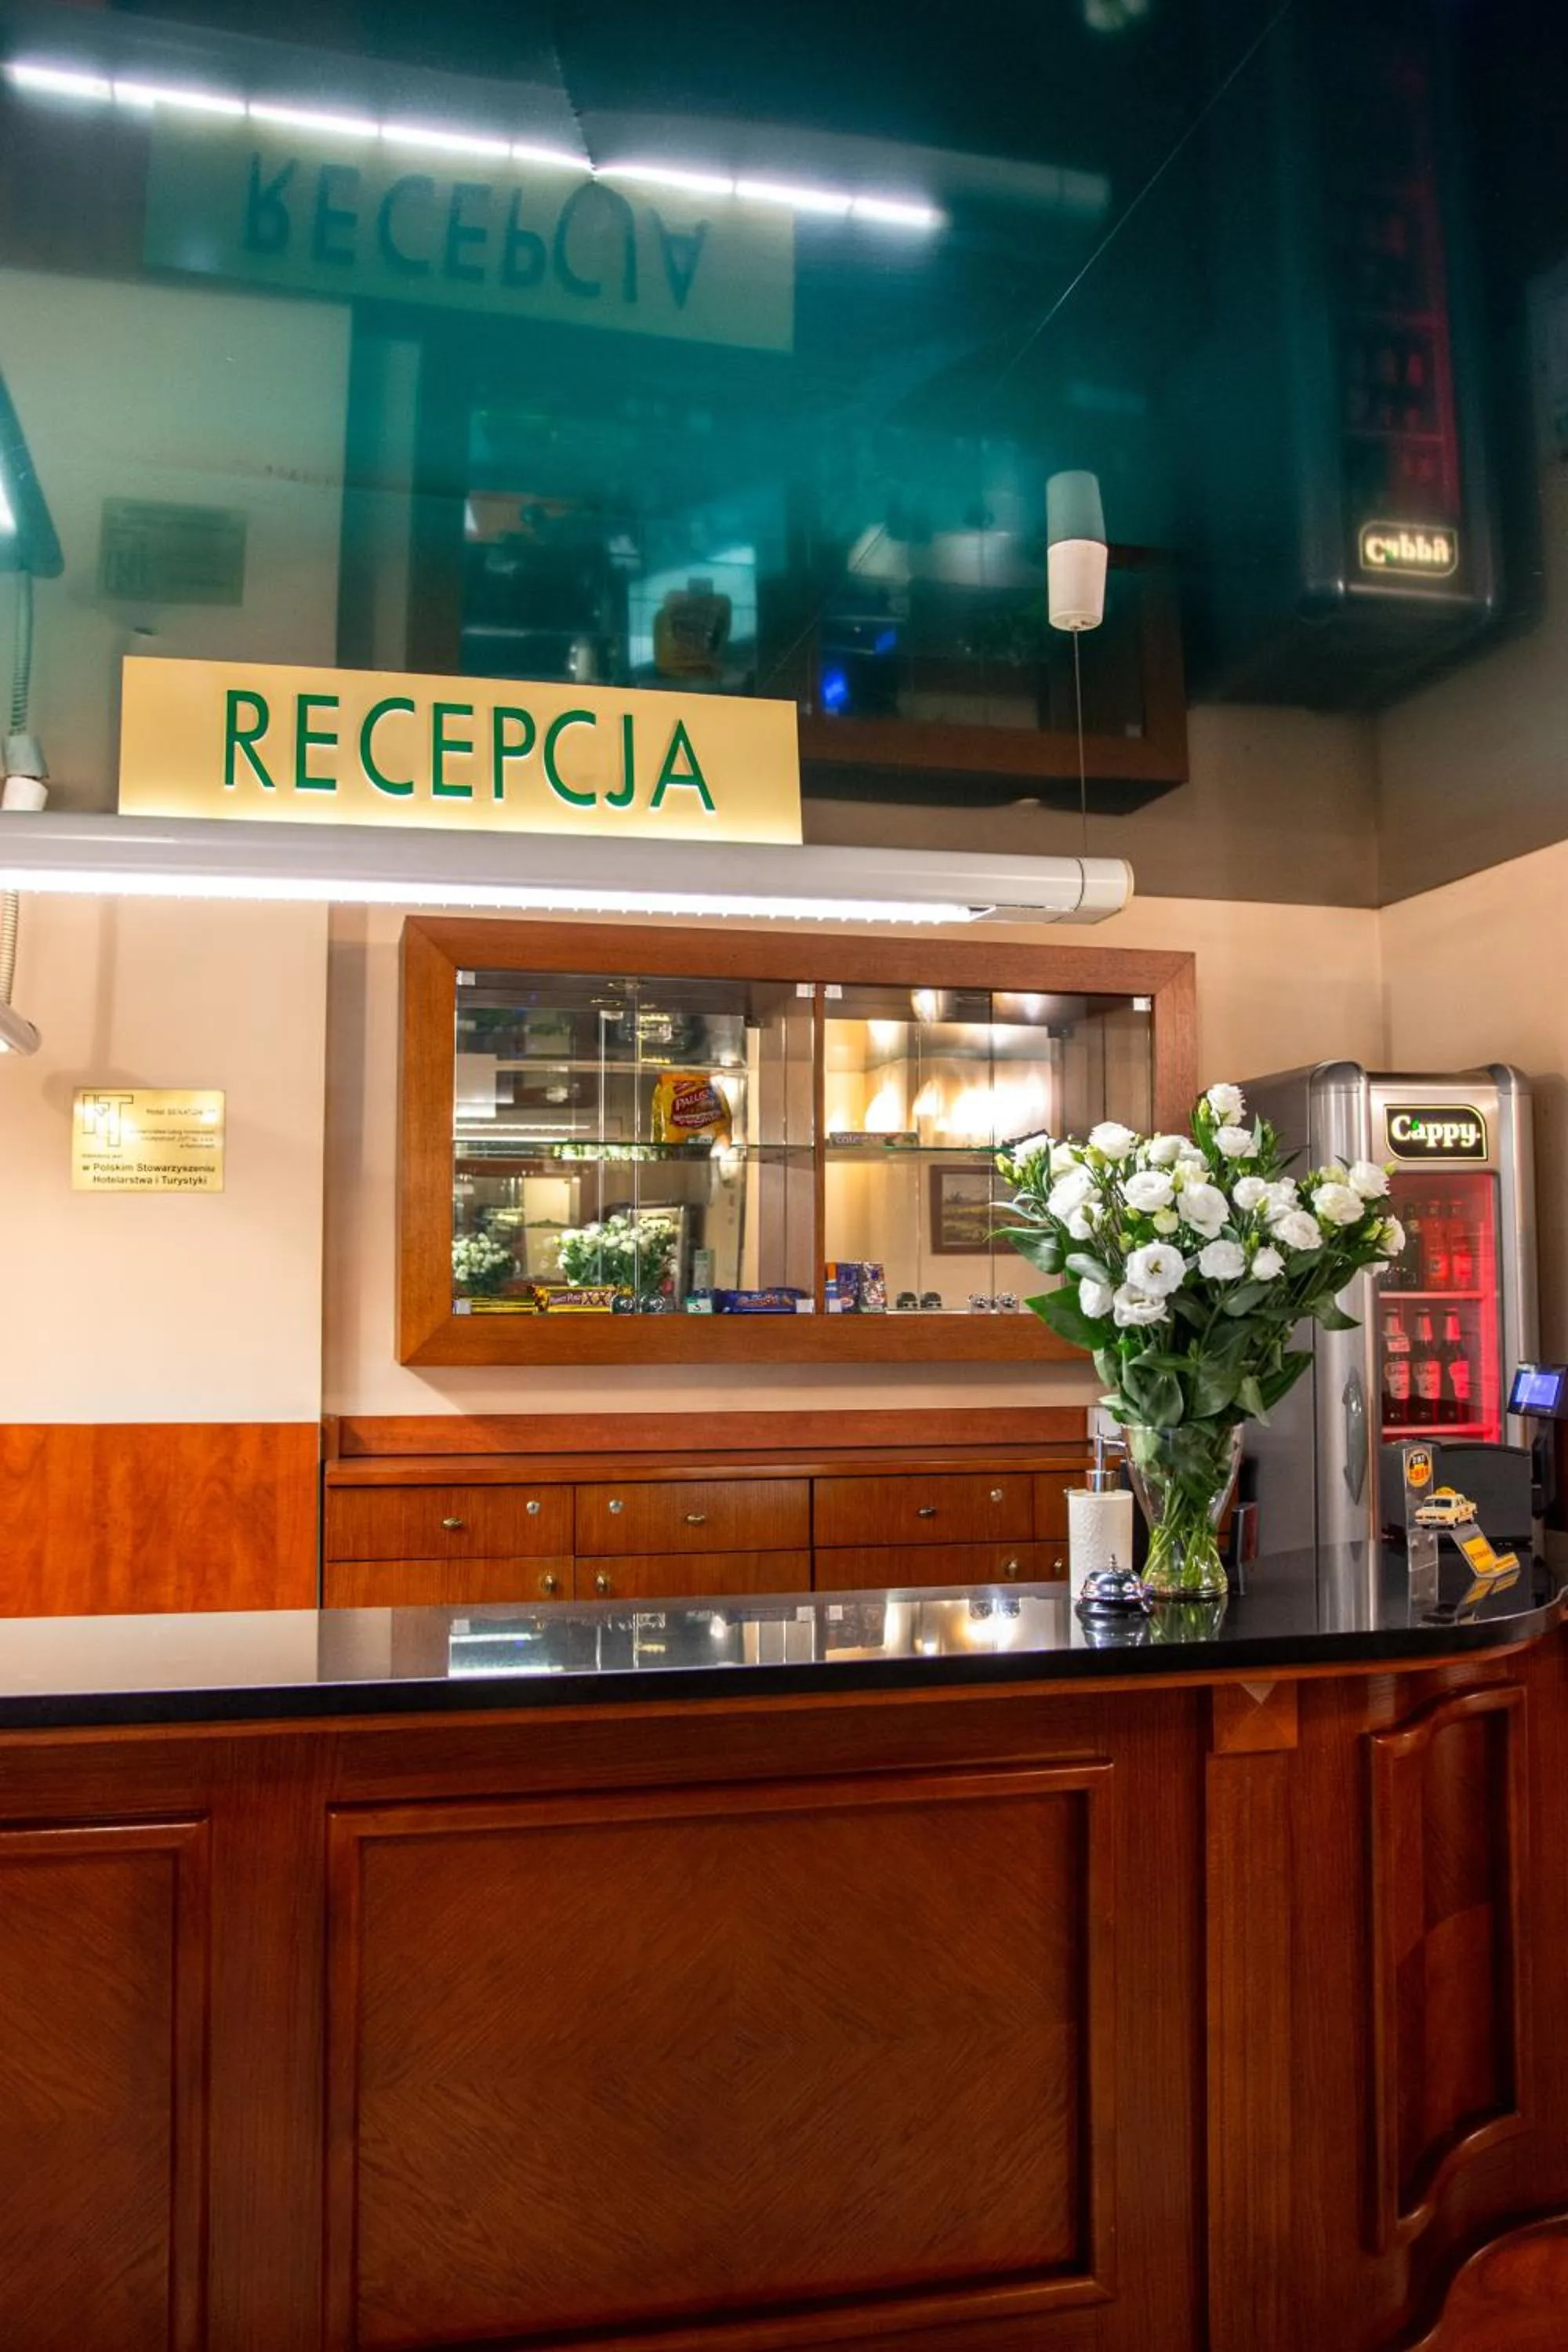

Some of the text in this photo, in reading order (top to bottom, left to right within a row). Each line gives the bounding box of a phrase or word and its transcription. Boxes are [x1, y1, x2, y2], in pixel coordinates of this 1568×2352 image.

[223, 688, 717, 813] RECEPCJA
[93, 1163, 134, 1172] Polskim
[137, 1163, 216, 1174] Stowarzyszeniu
[93, 1175, 153, 1185] Hotelarstwa
[162, 1175, 208, 1186] Turystyki
